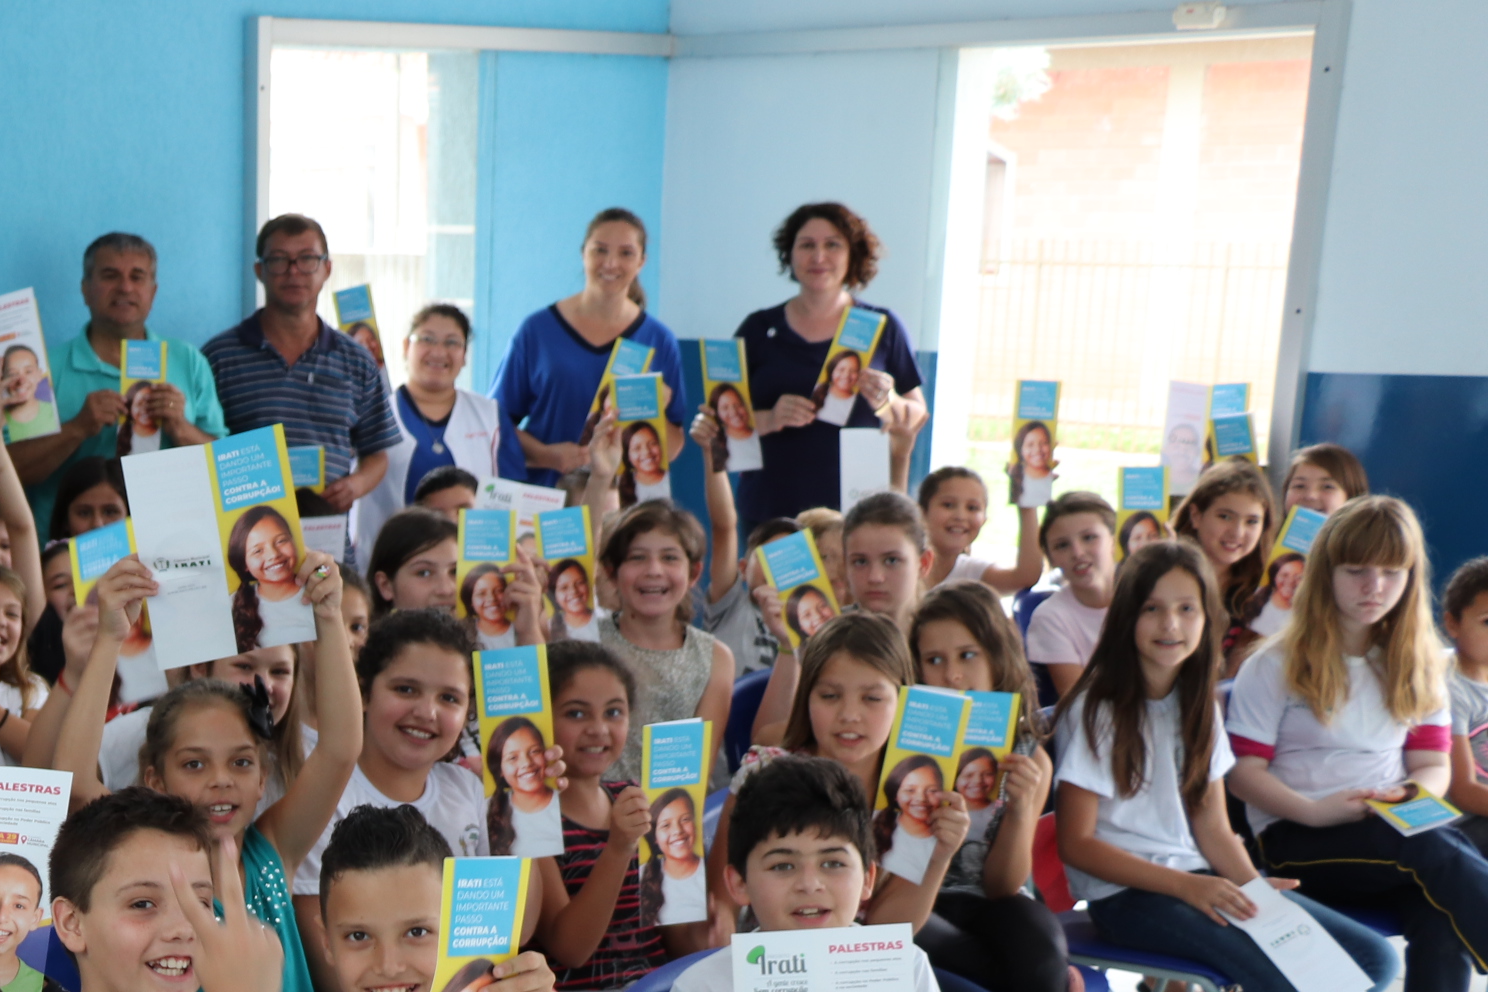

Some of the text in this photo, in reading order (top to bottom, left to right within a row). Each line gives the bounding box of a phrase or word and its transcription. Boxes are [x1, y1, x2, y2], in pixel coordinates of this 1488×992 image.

[217, 450, 239, 461] IRATI
[223, 481, 258, 495] CONTRA
[225, 485, 280, 504] CORRUPÇÃO!
[484, 662, 504, 670] IRATI
[487, 694, 519, 702] CONTRA
[488, 698, 538, 710] CORRUPÇÃO!
[457, 877, 503, 888] IRATI ESTÁ
[456, 890, 504, 900] DANDO UM
[456, 900, 509, 911] IMPORTANTE
[454, 913, 483, 924] PASSO
[453, 925, 497, 935] CONTRA A
[452, 934, 507, 948] CORRUPÇÃO!
[829, 941, 903, 954] PALESTRAS
[756, 954, 807, 974] Irati
